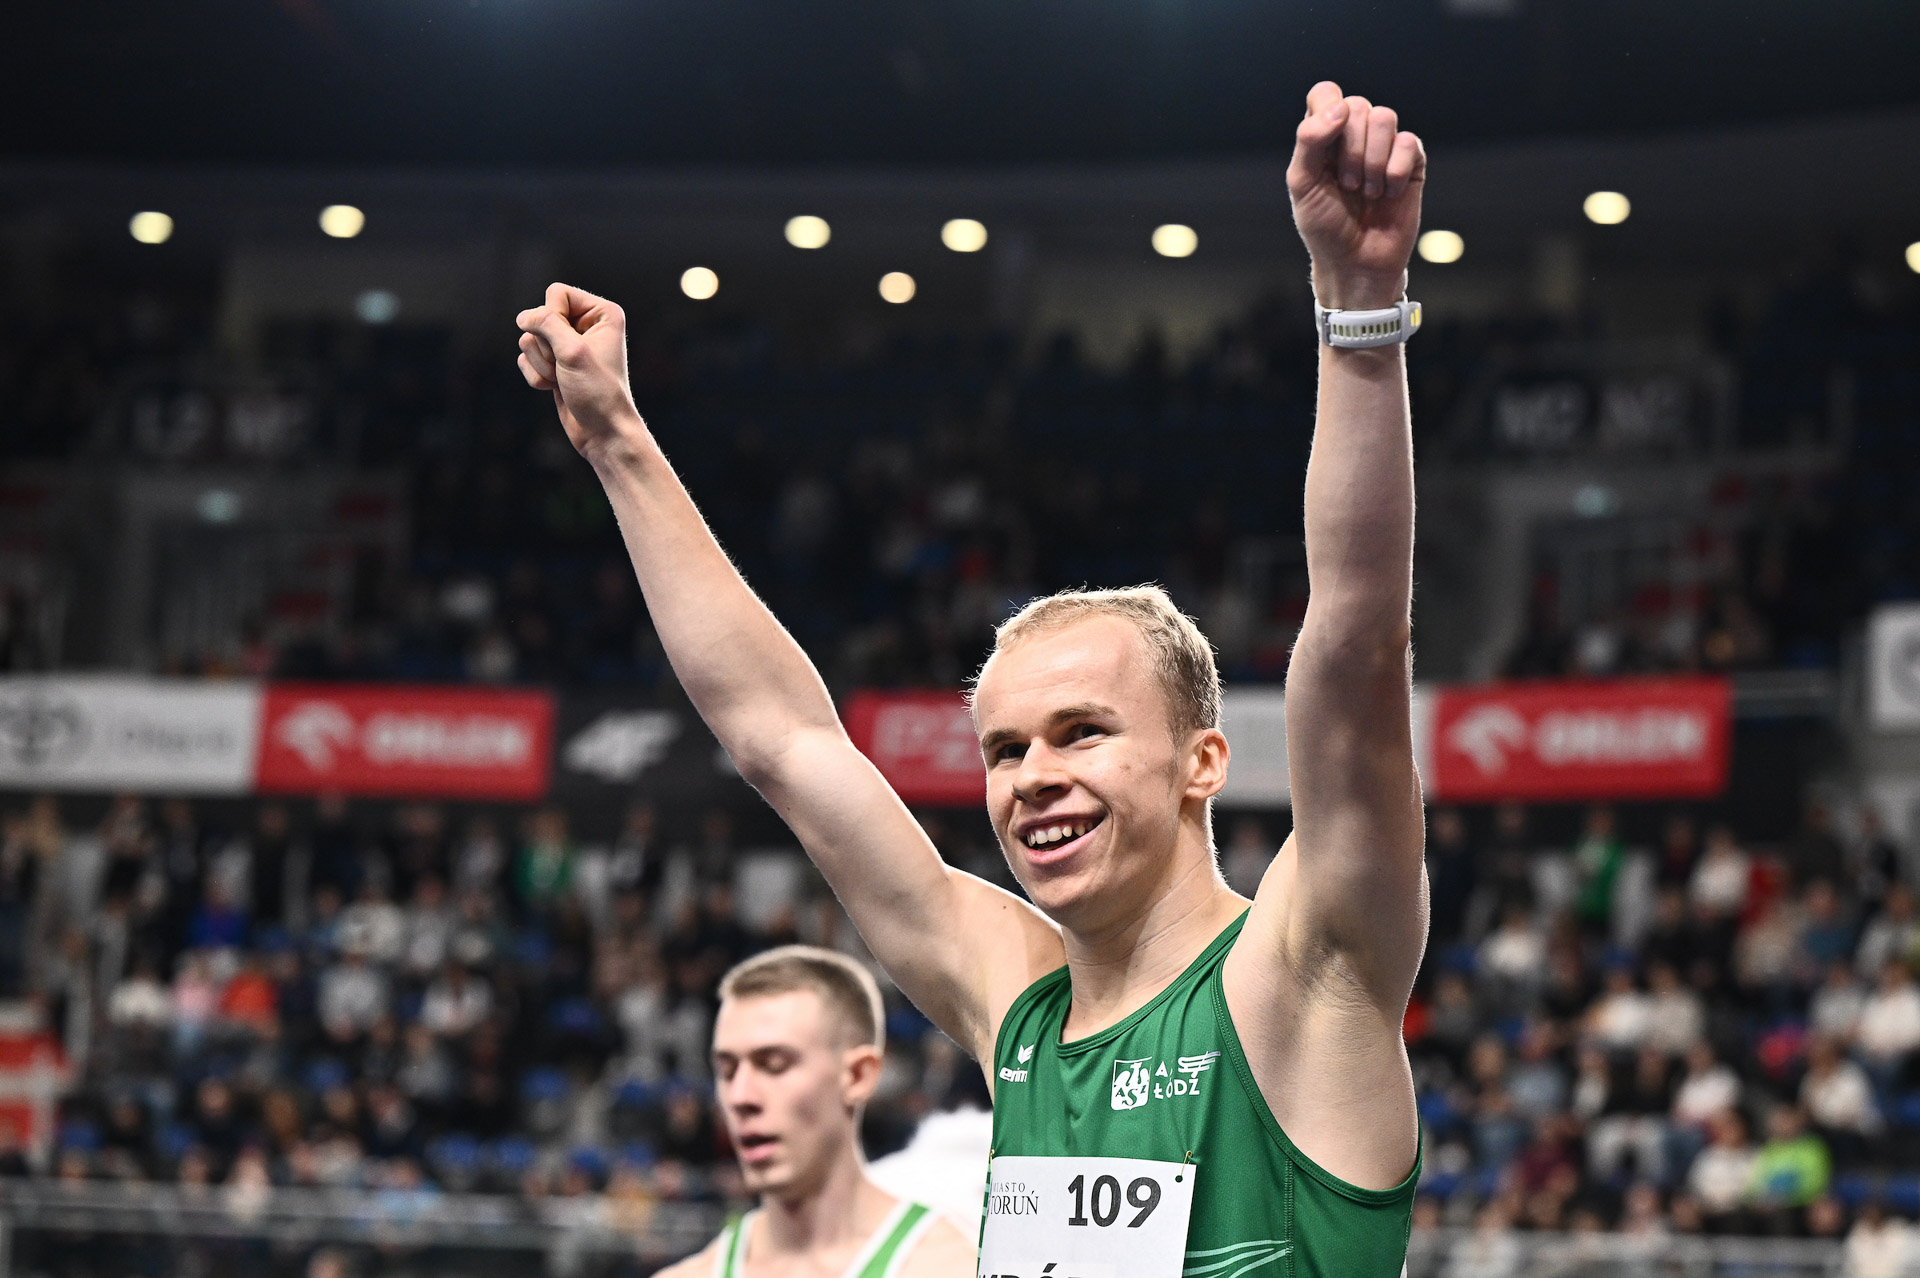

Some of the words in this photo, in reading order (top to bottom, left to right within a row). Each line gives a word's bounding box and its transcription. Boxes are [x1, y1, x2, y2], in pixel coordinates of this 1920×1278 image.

[1000, 1066, 1028, 1083] erim
[990, 1190, 1040, 1216] TORUŃ
[1067, 1174, 1162, 1229] 109
